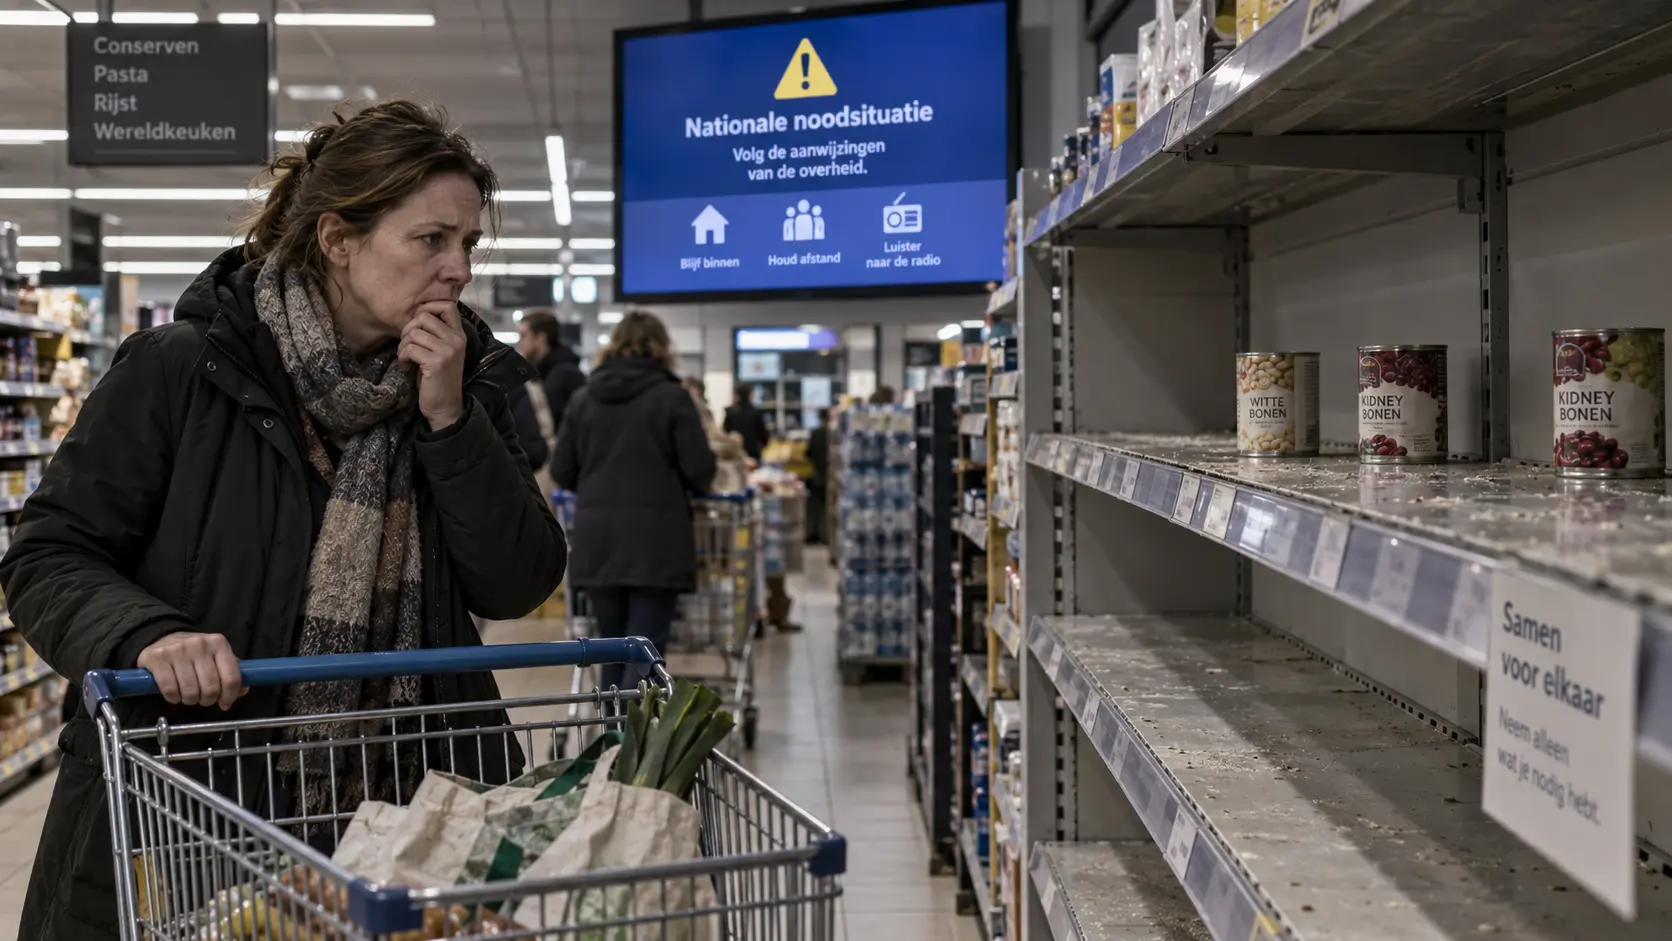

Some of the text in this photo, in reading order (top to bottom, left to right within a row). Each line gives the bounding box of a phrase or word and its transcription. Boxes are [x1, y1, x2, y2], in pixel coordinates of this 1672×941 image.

[93, 36, 200, 54] Conserven
[93, 64, 149, 83] Pasta
[94, 93, 138, 115] Rijst
[685, 100, 934, 138] Nationale noodsituatie
[93, 121, 236, 140] Wereldkeuken
[732, 140, 886, 164] Volg de aanwijzingen
[748, 159, 868, 181] van de overheid.
[883, 241, 922, 254] Luister
[680, 256, 740, 272] Blijf binnen
[767, 252, 841, 267] Houd afstand
[866, 252, 942, 269] naar de radio
[1250, 396, 1285, 407] WITTE
[1361, 395, 1404, 407] KIDNEY
[1558, 391, 1615, 405] KIDNEY
[1249, 408, 1287, 419] BONEN
[1362, 408, 1401, 420] BONEN
[1560, 407, 1613, 421] BONEN
[1503, 601, 1562, 653] Samen
[1501, 651, 1606, 721] voor elkaar
[1498, 705, 1570, 768] Neem alleen
[1497, 745, 1602, 828] wat je nodig hebt.
